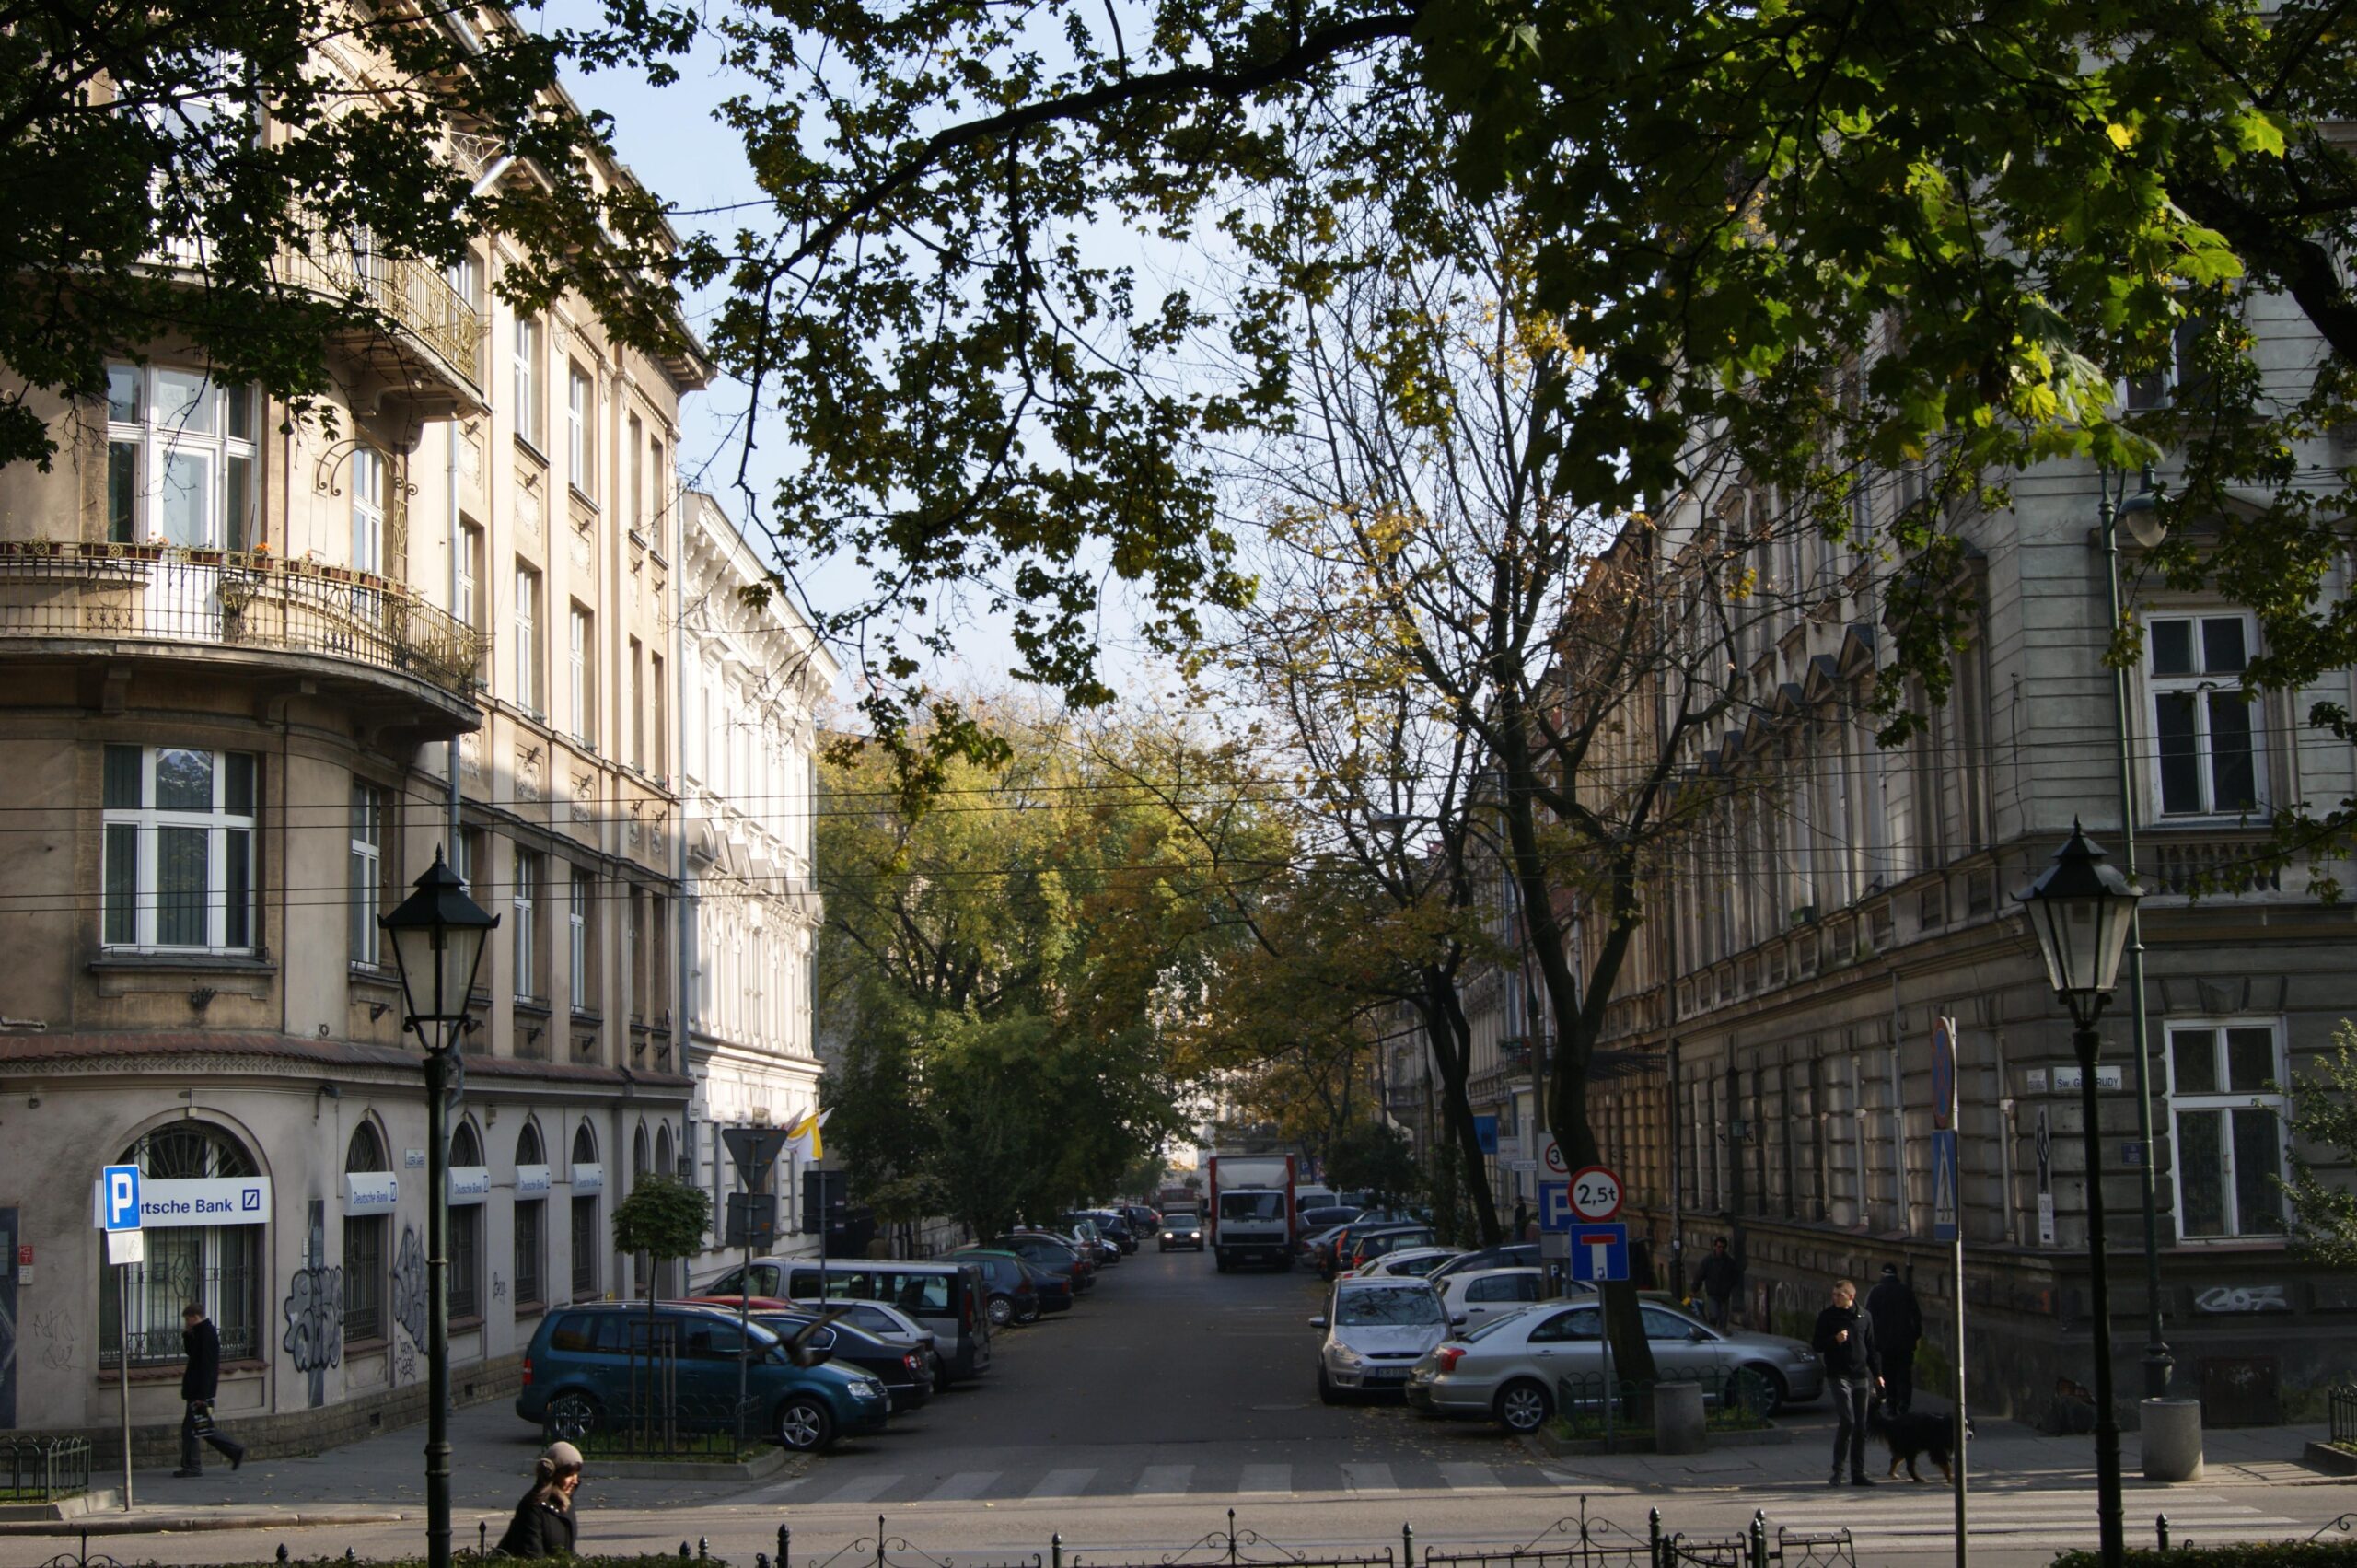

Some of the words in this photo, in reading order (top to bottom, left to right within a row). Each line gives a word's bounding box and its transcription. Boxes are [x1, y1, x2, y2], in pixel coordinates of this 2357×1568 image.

[2073, 1077, 2119, 1087] GRUDY
[1550, 1149, 1561, 1164] 3
[111, 1173, 134, 1224] P
[353, 1191, 376, 1205] Deutsche
[377, 1190, 389, 1203] Bank
[1578, 1184, 1617, 1206] 2,5t
[141, 1199, 191, 1214] tsche
[195, 1198, 233, 1214] Bank
